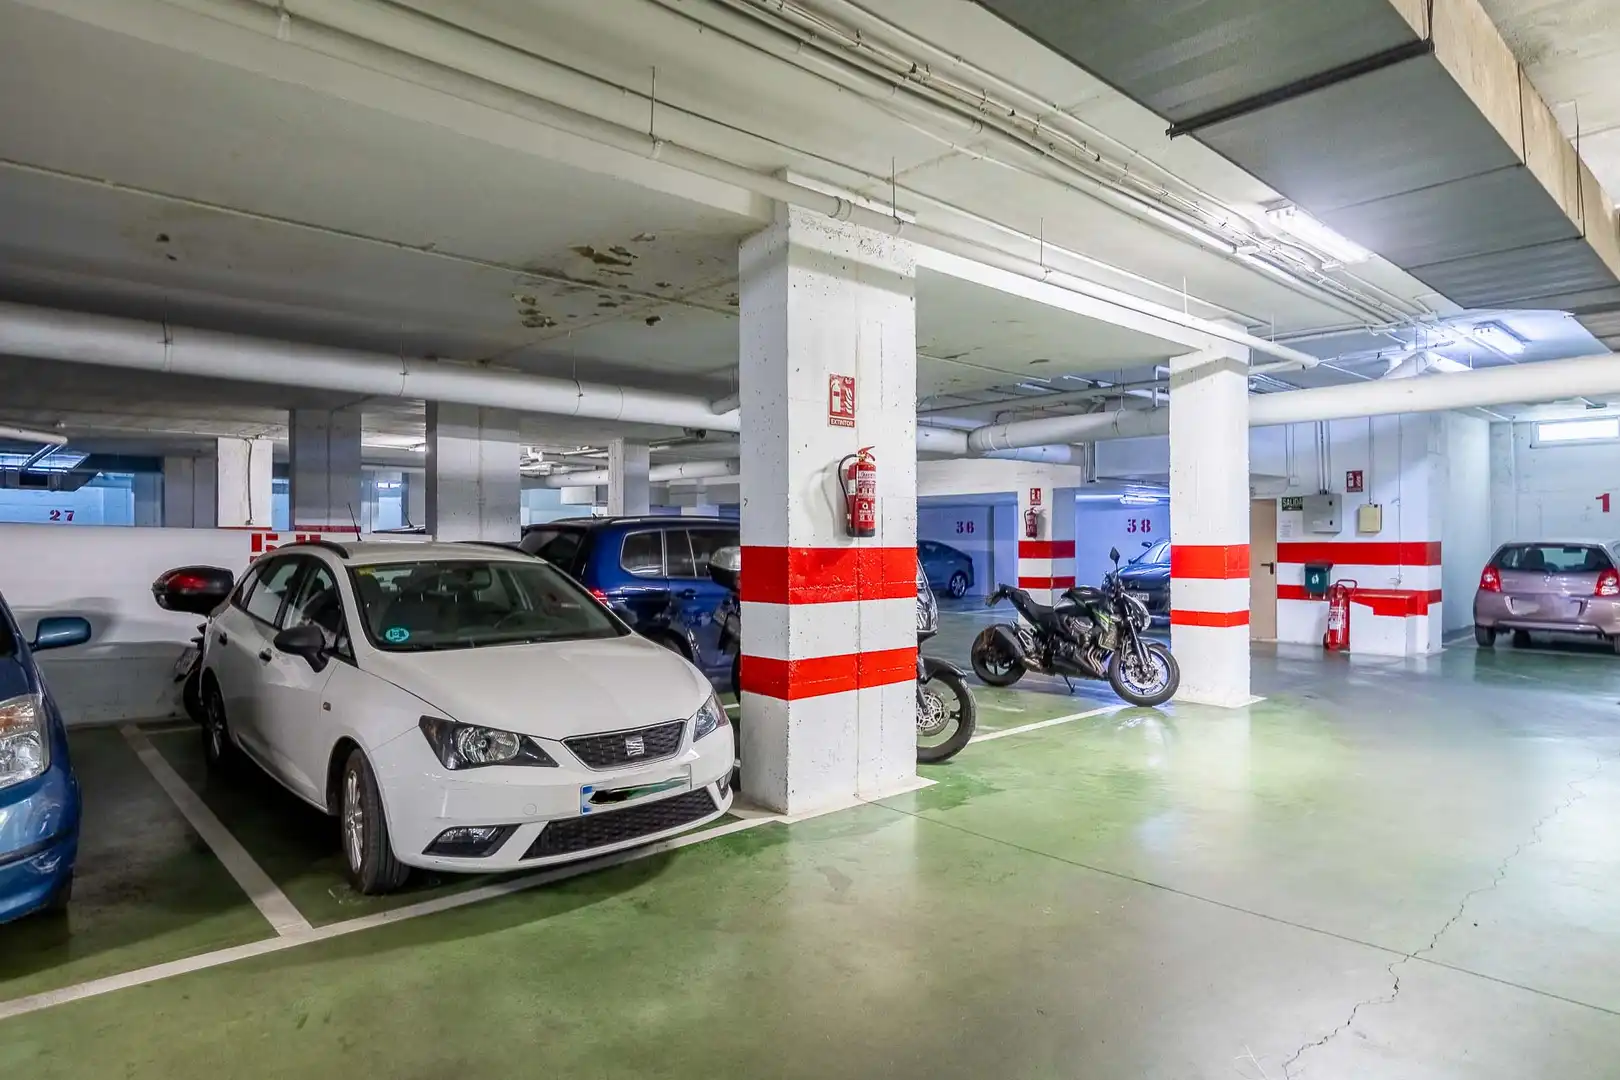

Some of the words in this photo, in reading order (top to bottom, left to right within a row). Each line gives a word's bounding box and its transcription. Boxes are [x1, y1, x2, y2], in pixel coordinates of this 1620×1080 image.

[831, 419, 854, 427] EXTINTOR
[1282, 497, 1303, 508] SALIDA
[1595, 493, 1610, 513] 1
[49, 509, 75, 522] 27
